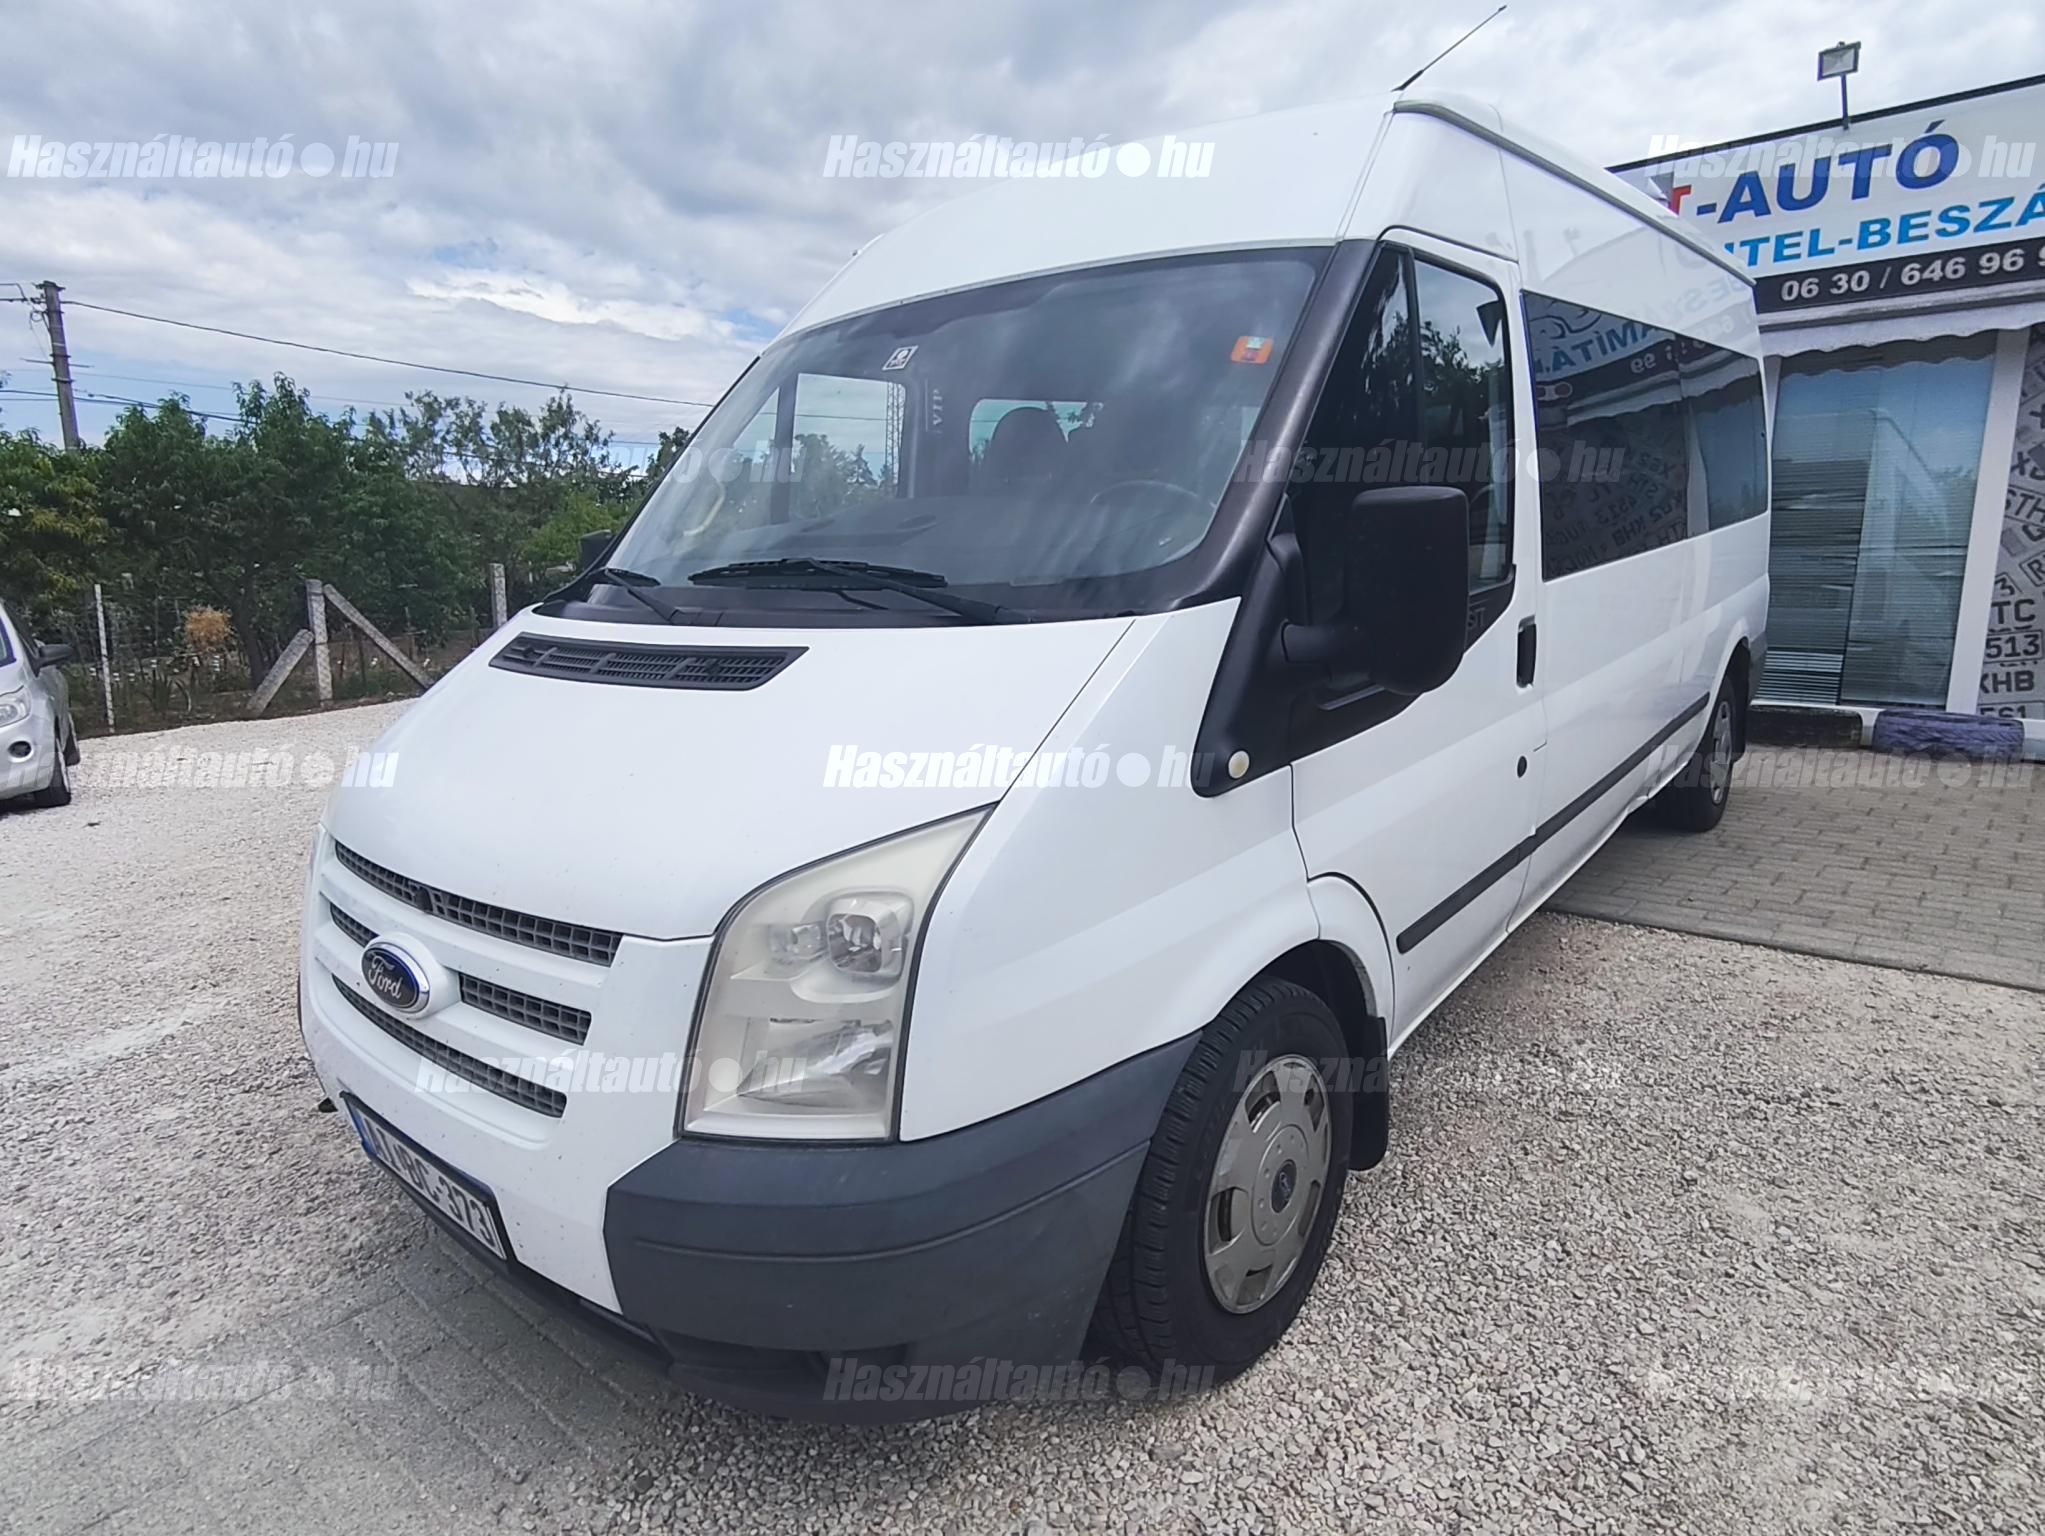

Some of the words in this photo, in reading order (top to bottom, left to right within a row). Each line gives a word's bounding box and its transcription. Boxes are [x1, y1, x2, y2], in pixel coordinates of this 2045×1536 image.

[1781, 277, 1819, 301] 06
[1830, 271, 1870, 295] 30
[1901, 257, 1966, 285] 646
[1979, 249, 2024, 275] 96
[1985, 634, 2040, 659] 513
[369, 955, 404, 999] Ford
